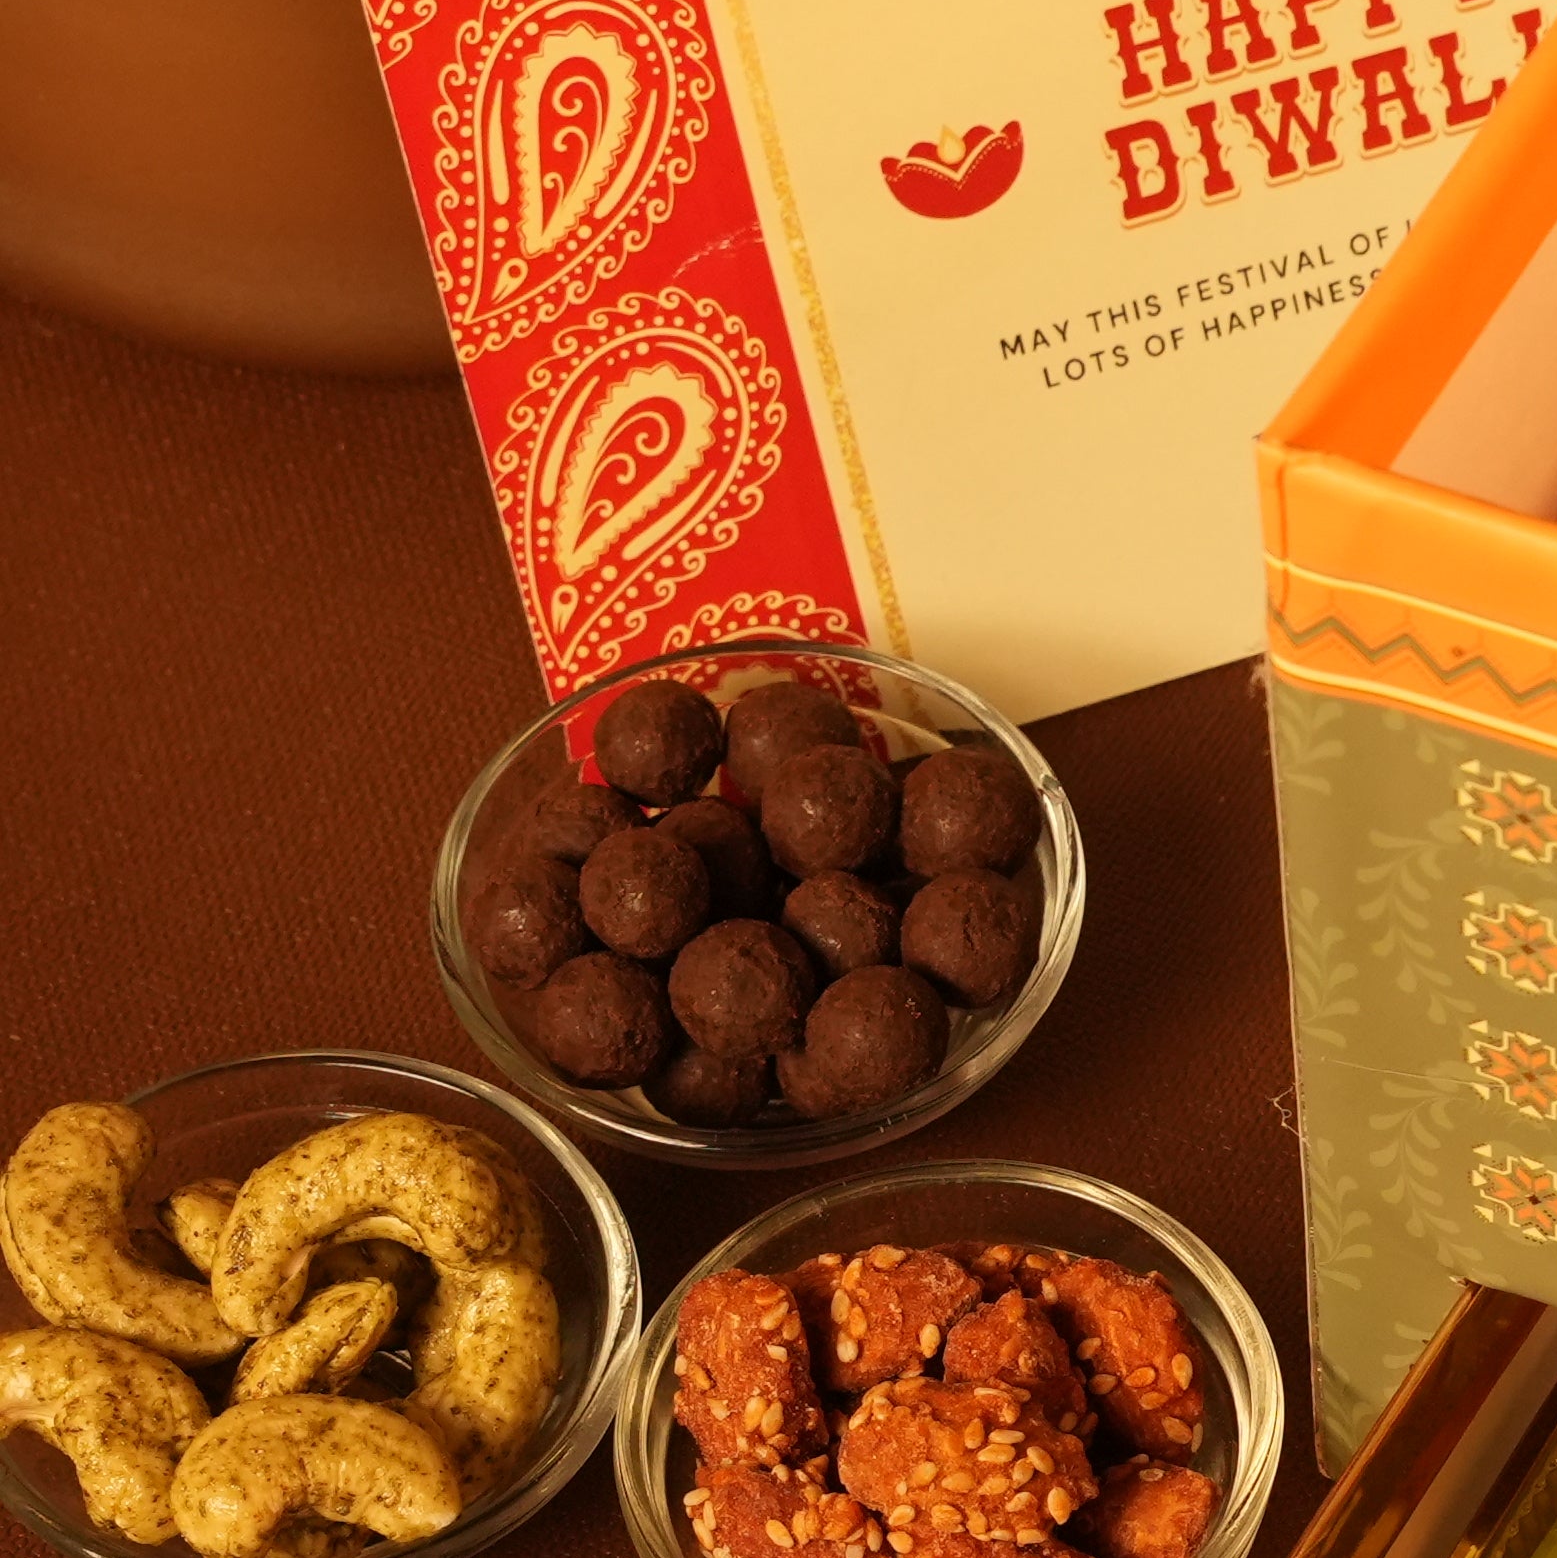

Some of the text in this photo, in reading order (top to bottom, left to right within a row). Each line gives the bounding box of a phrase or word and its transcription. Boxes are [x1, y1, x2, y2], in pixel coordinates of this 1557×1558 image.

[999, 319, 1071, 360] MAY
[1086, 294, 1163, 334] THIS
[1177, 244, 1335, 308] FESTIVAL
[1349, 226, 1391, 256] OF
[1043, 345, 1130, 389] LOTS
[1144, 327, 1186, 358] OF
